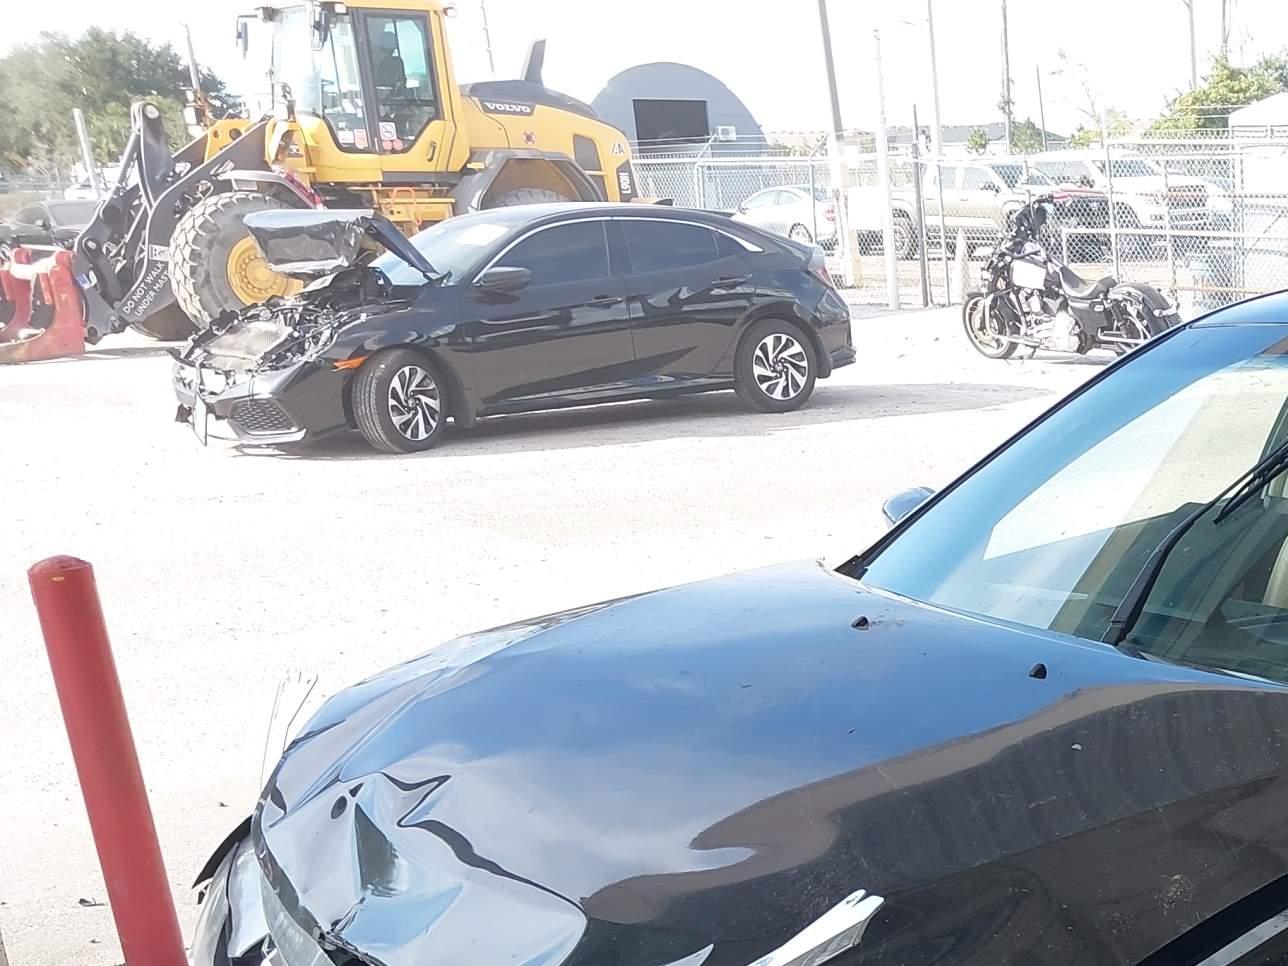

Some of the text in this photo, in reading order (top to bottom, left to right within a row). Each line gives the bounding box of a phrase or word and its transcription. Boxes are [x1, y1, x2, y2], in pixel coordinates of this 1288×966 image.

[484, 102, 532, 113] VOLVO
[122, 301, 135, 314] DO
[133, 282, 148, 301] NOT
[144, 262, 166, 284] WALK
[134, 291, 157, 316] UNDER
[154, 269, 170, 293] MAST
